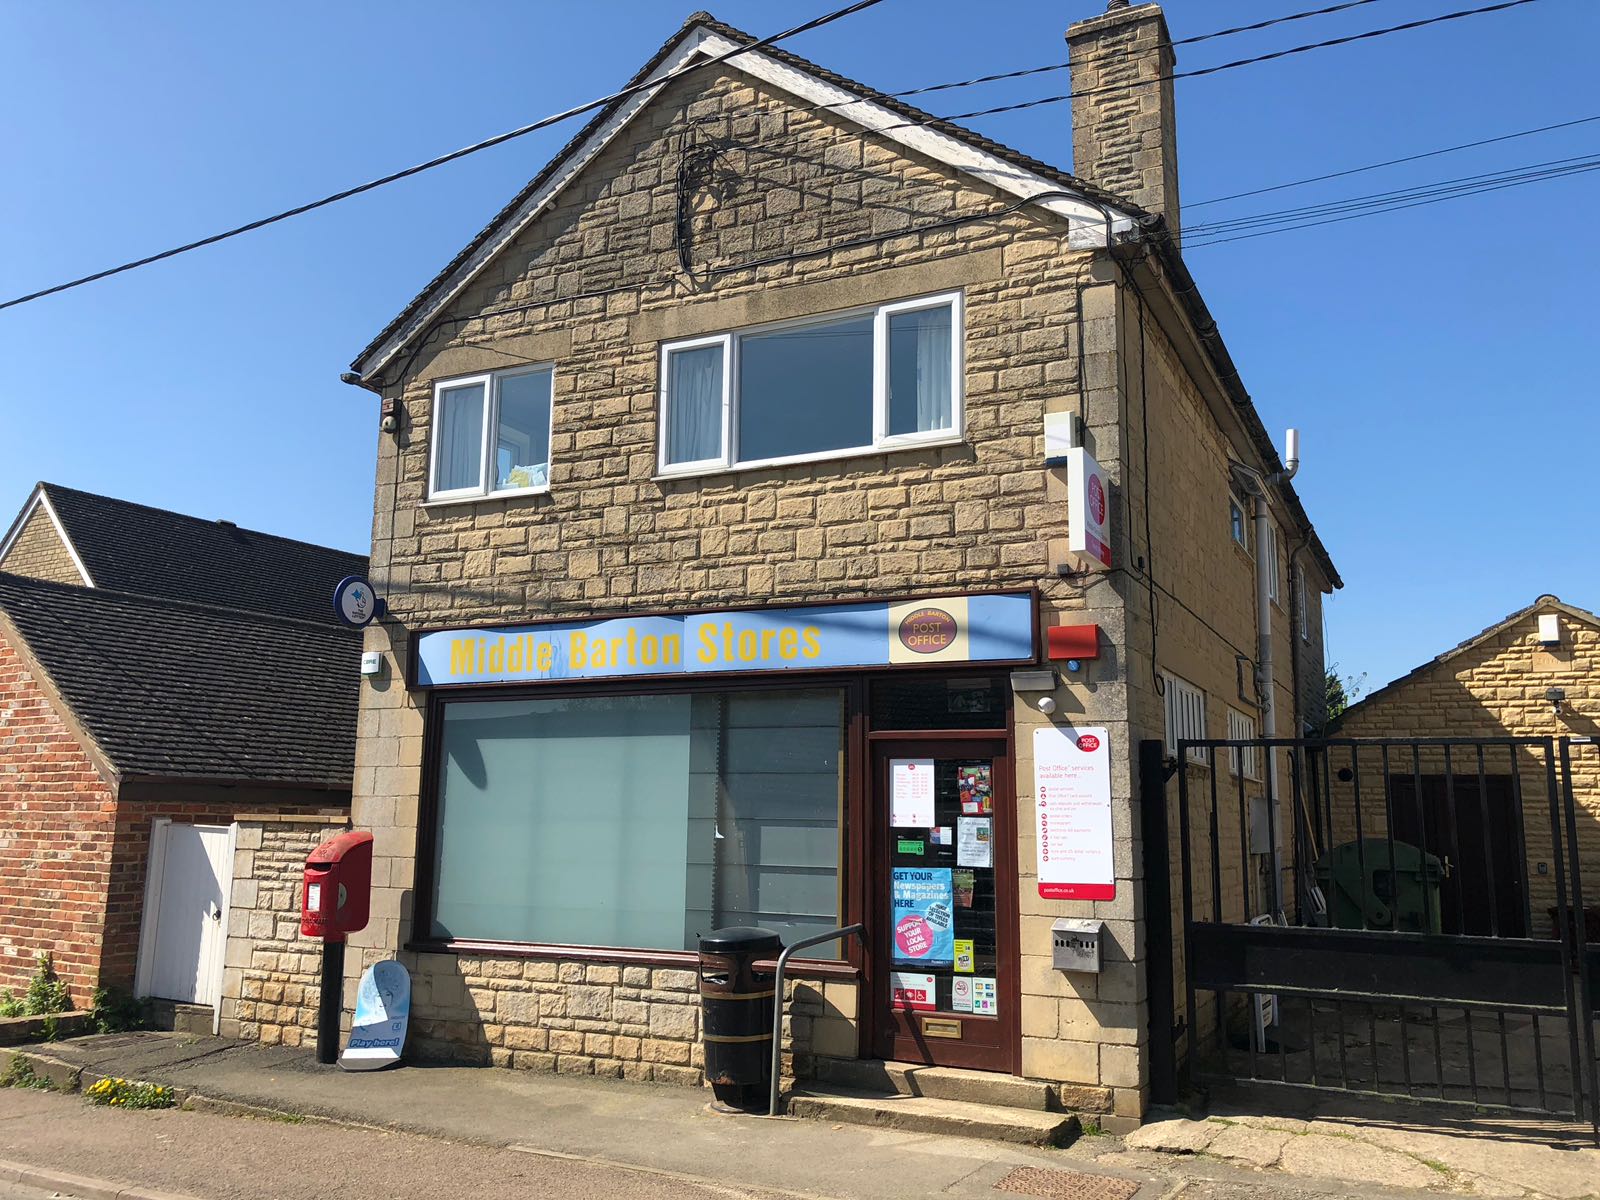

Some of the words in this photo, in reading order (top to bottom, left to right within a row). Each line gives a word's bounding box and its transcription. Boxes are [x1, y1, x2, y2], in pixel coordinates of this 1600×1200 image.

[927, 611, 951, 623] BARTON
[912, 622, 942, 634] POST
[907, 634, 947, 646] OFFICE
[451, 634, 553, 676] Middle
[569, 627, 681, 670] Barton
[697, 621, 822, 664] Stores
[893, 871, 909, 880] GET
[910, 871, 933, 881] YOUR
[894, 881, 946, 892] Newspapers
[902, 890, 950, 901] Magazines
[894, 899, 915, 908] HERE
[929, 906, 951, 919] SELECTION
[935, 913, 949, 924] TITLES
[896, 918, 924, 934] SUPPORT
[926, 916, 948, 929] AVAILABLE
[903, 927, 922, 939] YOUR
[906, 934, 925, 946] LOCAL
[908, 941, 928, 954] STORE
[350, 1039, 371, 1048] Play
[372, 1037, 400, 1047] here!
